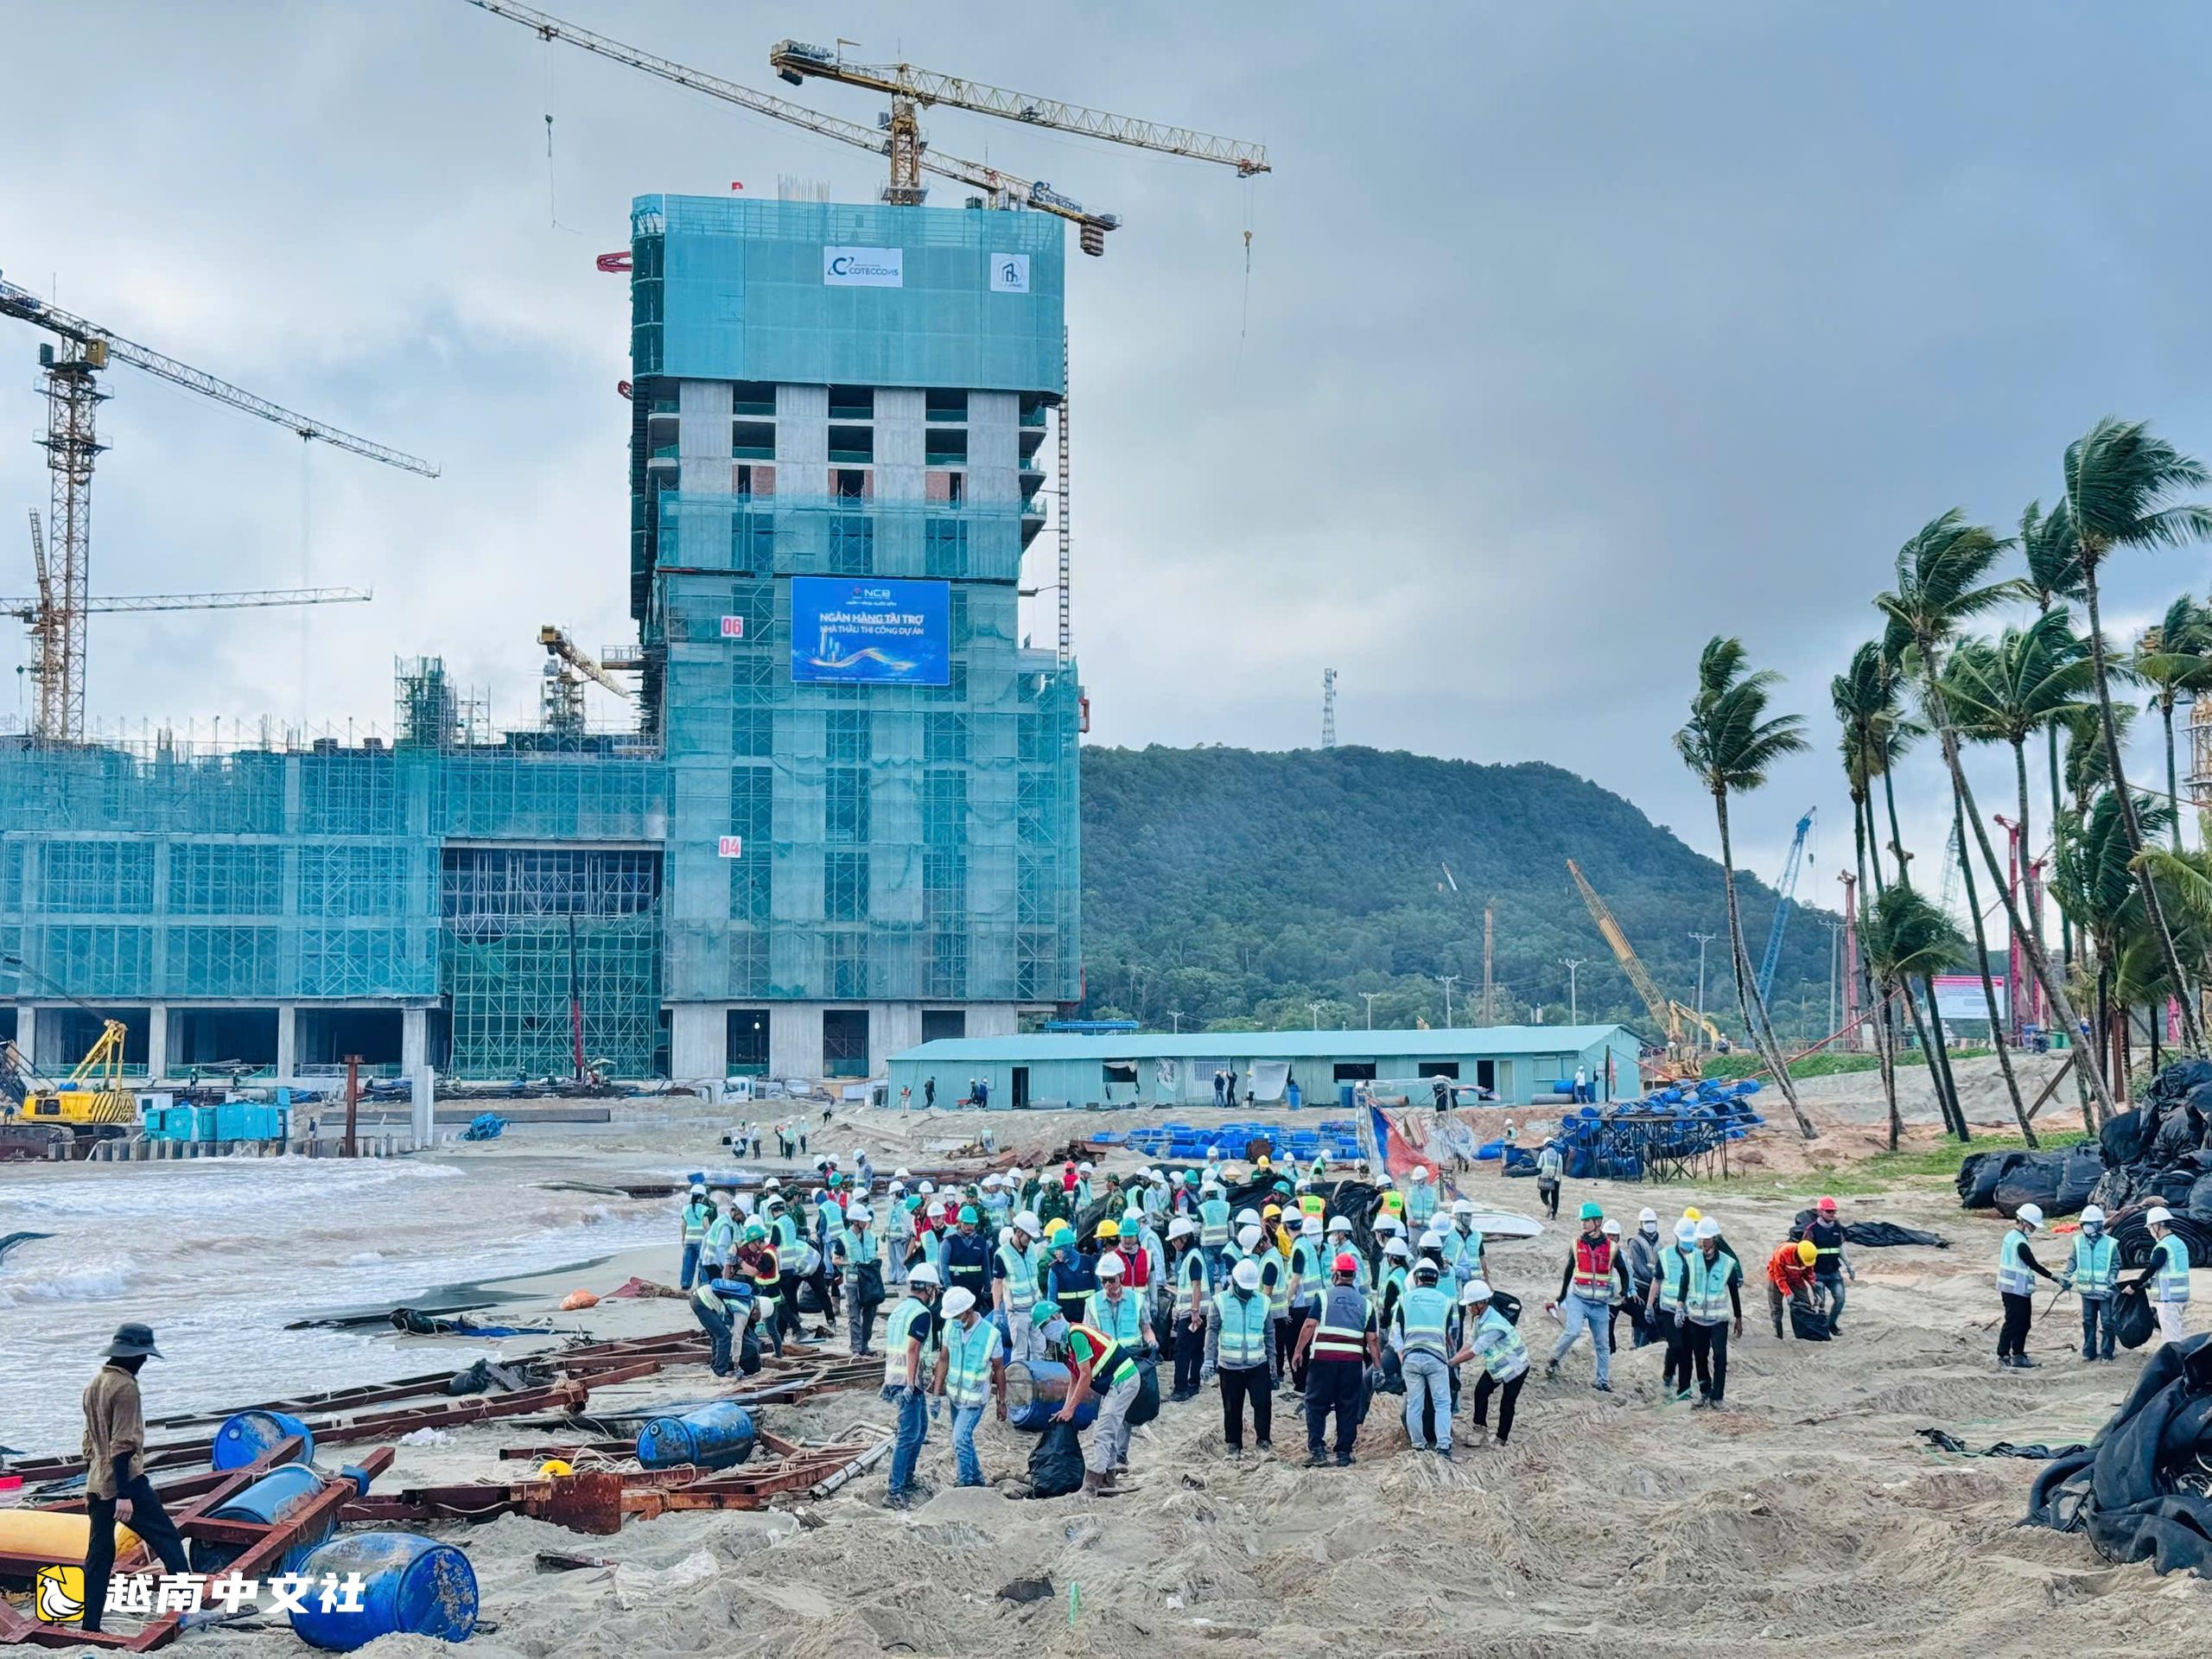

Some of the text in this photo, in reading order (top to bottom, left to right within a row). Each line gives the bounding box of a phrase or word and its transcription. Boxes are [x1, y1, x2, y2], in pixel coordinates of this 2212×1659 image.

[864, 588, 891, 597] NCB
[852, 611, 883, 624] HÀNG
[884, 612, 900, 625] TÀI
[722, 618, 742, 635] 06
[874, 625, 898, 635] CÔNG
[720, 838, 740, 855] 04
